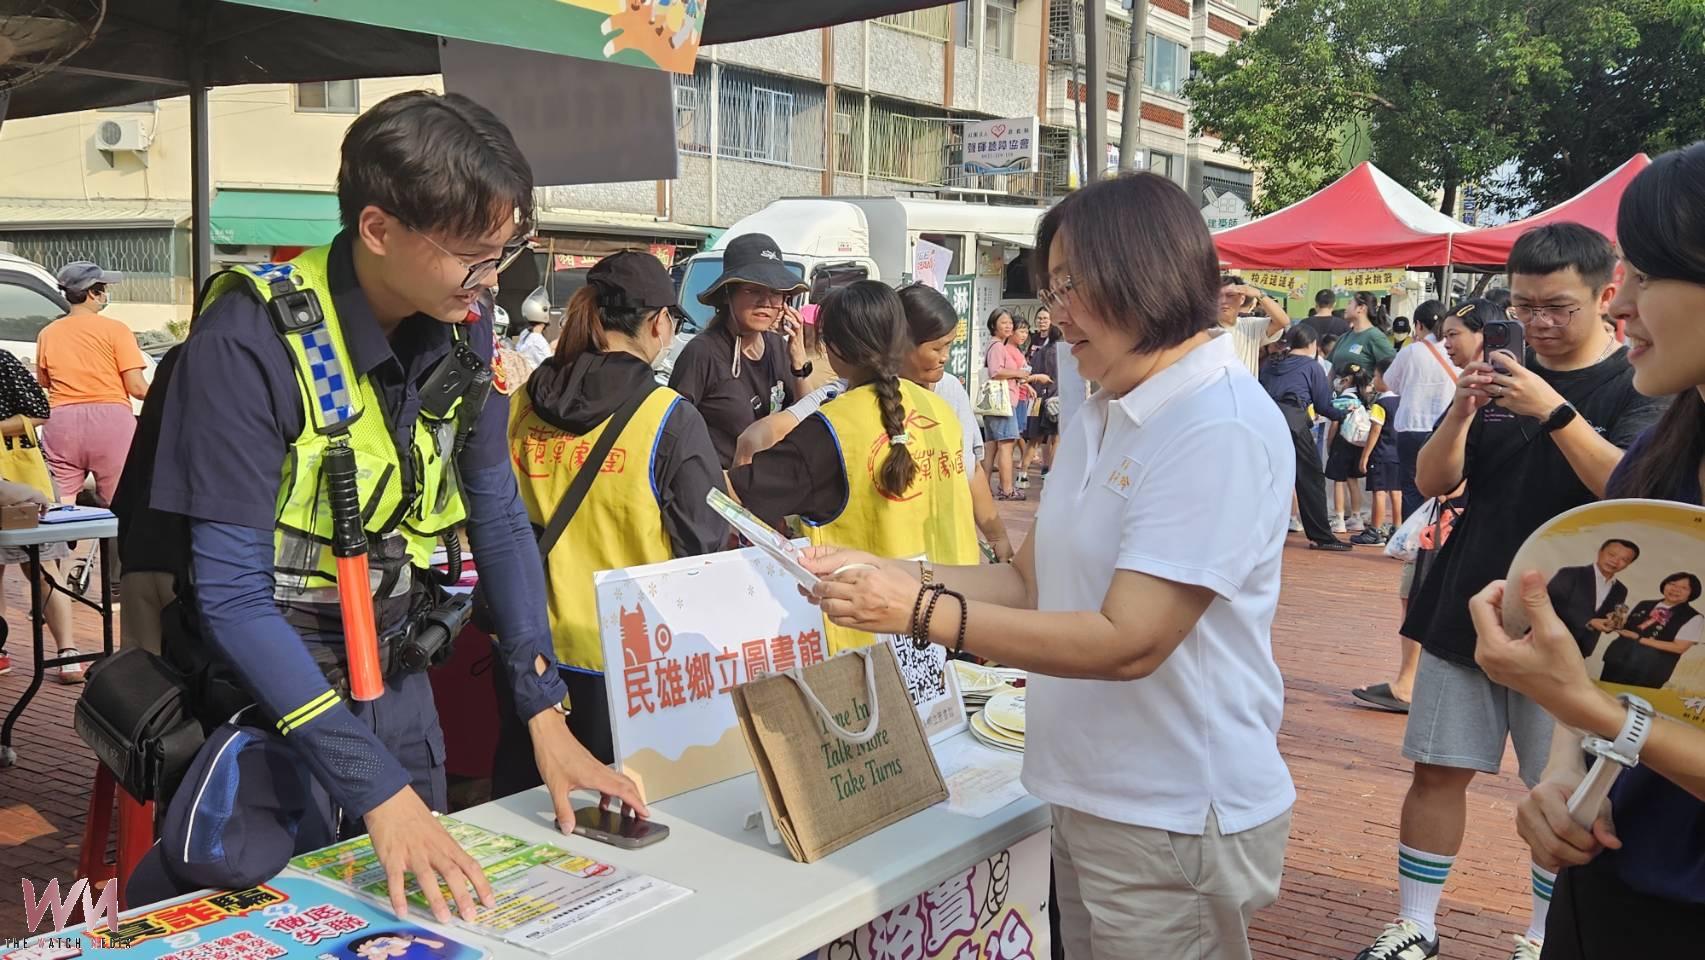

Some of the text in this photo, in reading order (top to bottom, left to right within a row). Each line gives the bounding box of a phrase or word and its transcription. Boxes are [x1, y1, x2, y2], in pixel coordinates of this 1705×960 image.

[623, 628, 825, 718] 民雄鄉立圖書館
[851, 697, 871, 721] In
[820, 738, 854, 769] Talk
[830, 758, 903, 801] Take Turns
